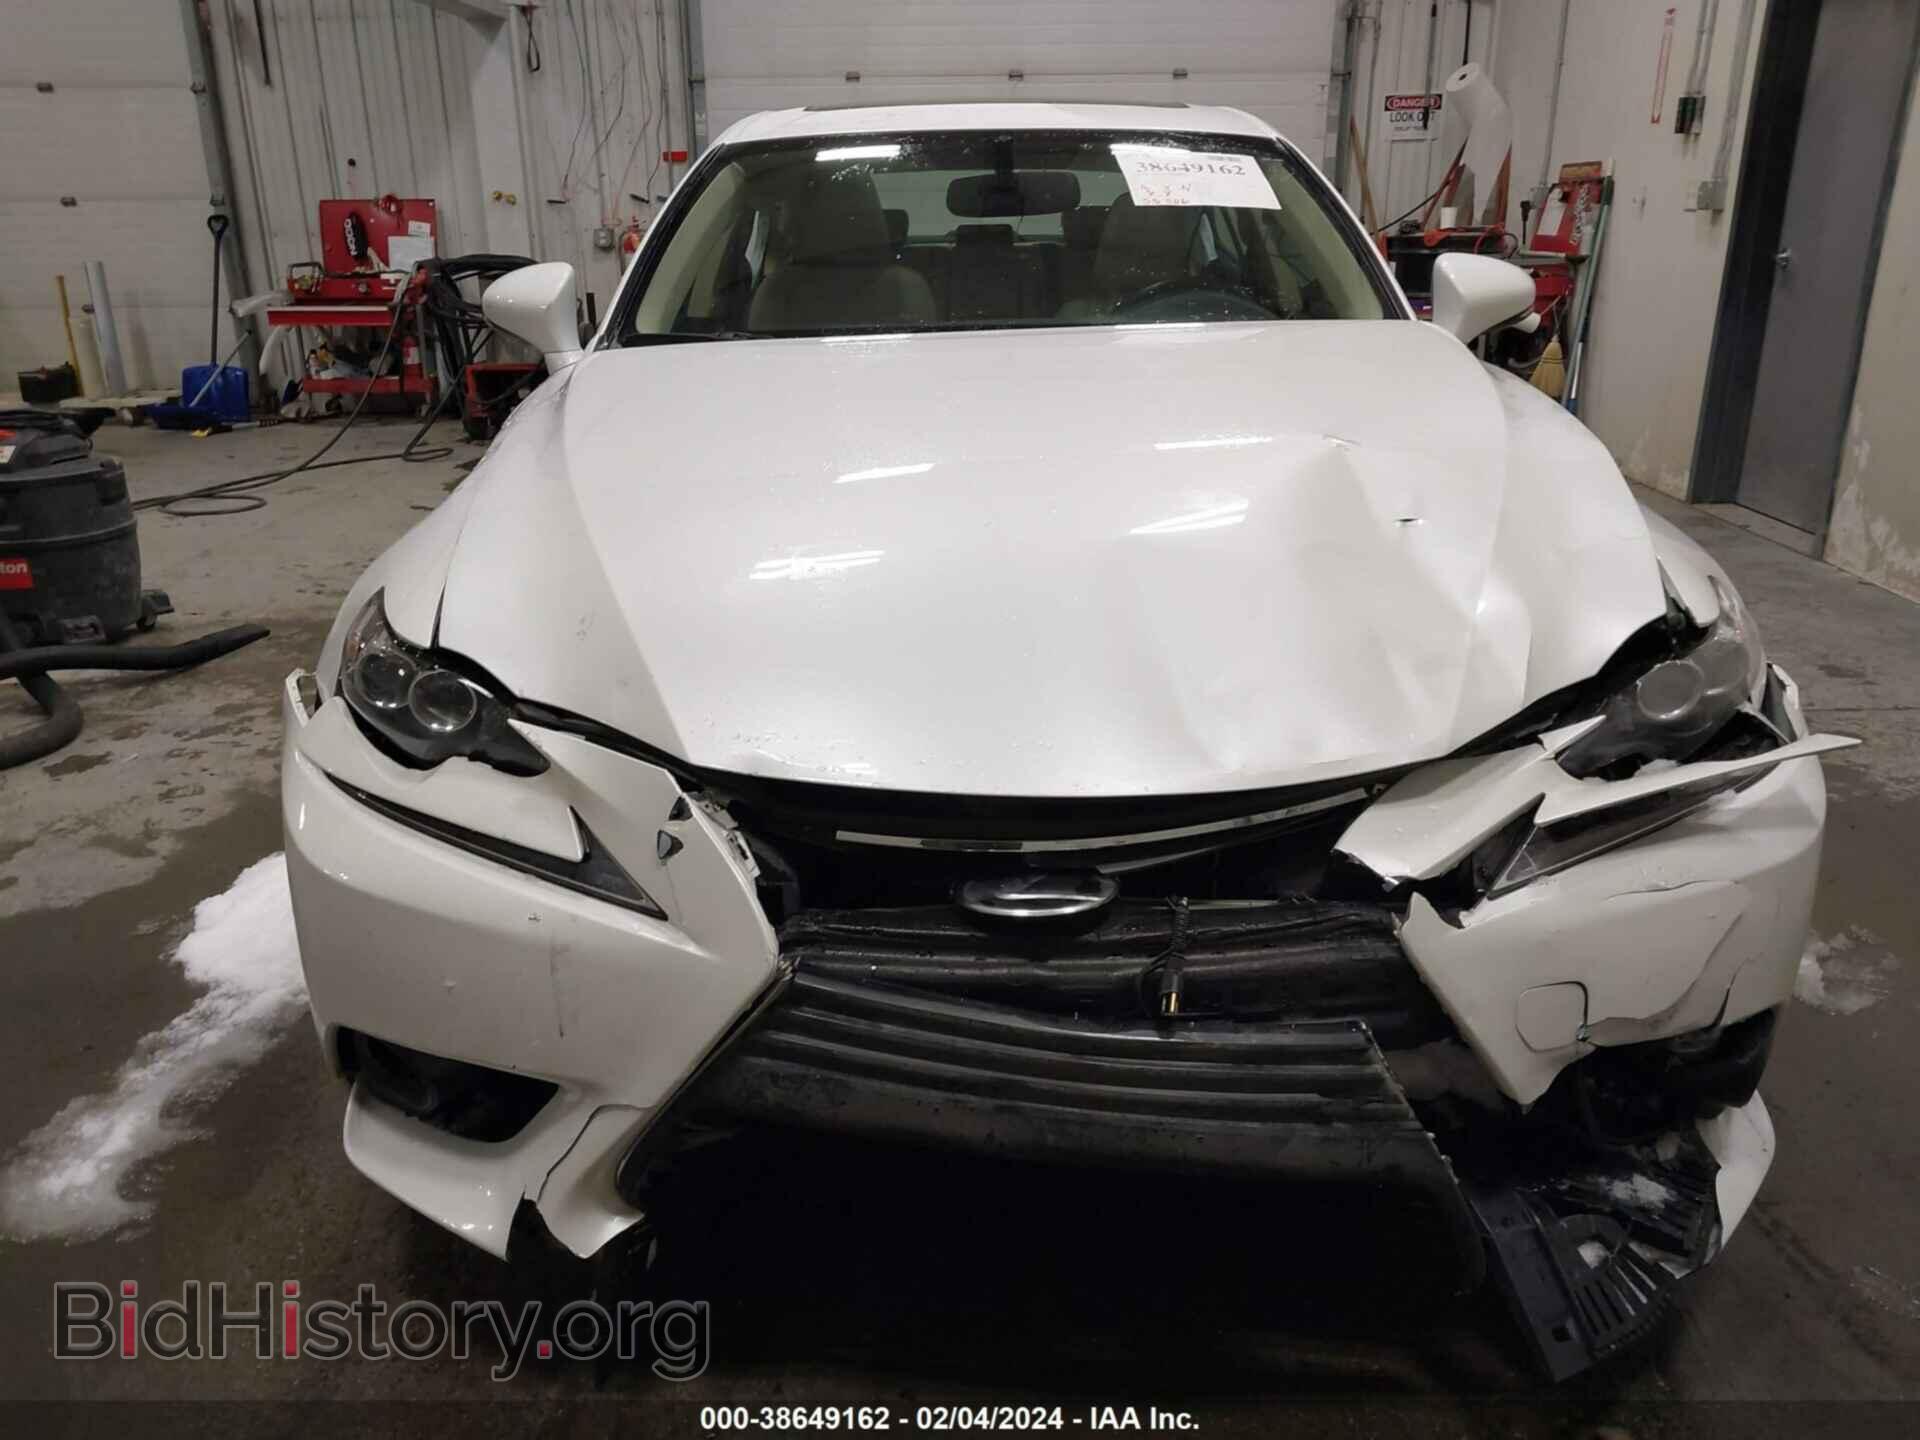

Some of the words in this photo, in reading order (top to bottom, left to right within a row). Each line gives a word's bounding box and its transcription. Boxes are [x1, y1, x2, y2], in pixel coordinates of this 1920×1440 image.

[1390, 111, 1416, 122] LOOK
[1417, 111, 1437, 121] OT
[1136, 161, 1246, 176] 38649162
